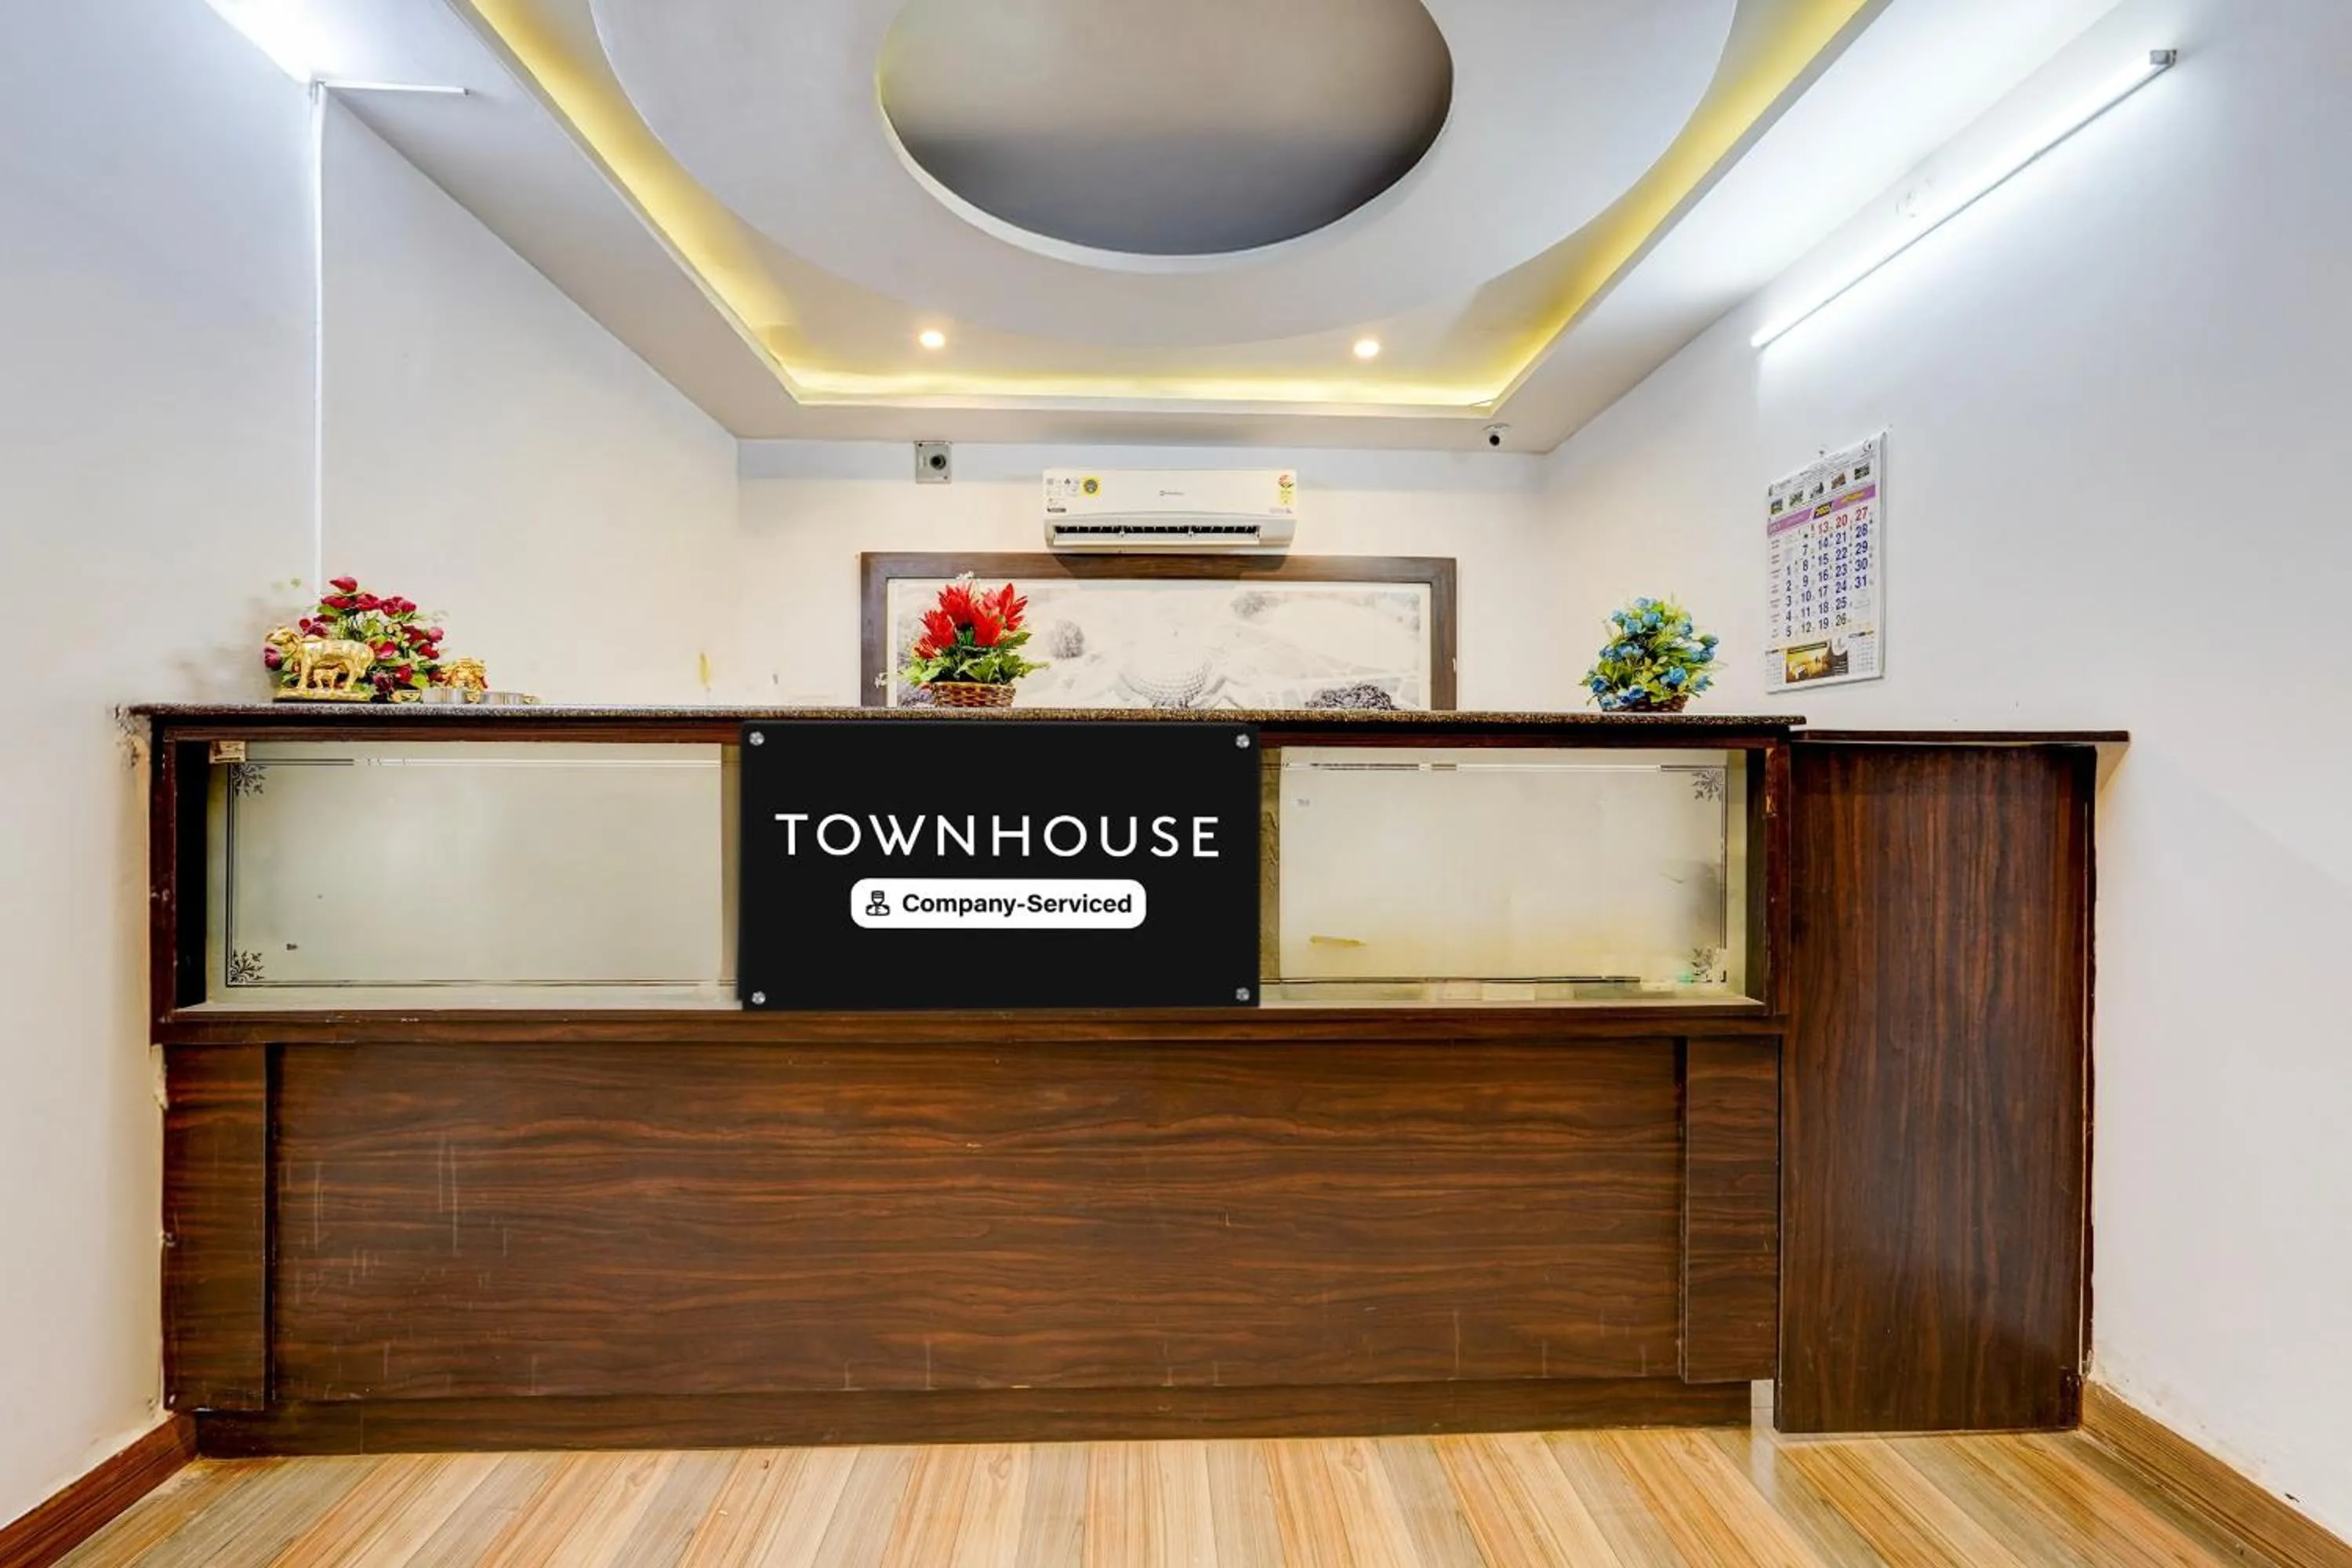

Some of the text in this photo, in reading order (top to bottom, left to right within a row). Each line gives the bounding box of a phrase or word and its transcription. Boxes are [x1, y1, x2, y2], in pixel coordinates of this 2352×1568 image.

[1818, 521, 1829, 534] 13
[1835, 514, 1848, 528] 20
[1856, 506, 1868, 521] 27
[1835, 532, 1846, 544] 21
[1818, 553, 1829, 566] 15
[1835, 547, 1848, 561] 22
[1856, 540, 1868, 555] 29
[1818, 568, 1829, 582] 16
[1835, 563, 1848, 577] 23
[1855, 557, 1868, 572] 30
[1802, 590, 1812, 602] 10
[1818, 585, 1828, 597] 17
[1835, 579, 1846, 593] 24
[1855, 575, 1867, 588] 31
[1802, 606, 1810, 618] 11
[1818, 601, 1829, 614] 18
[1835, 596, 1847, 610] 25
[1802, 621, 1812, 633] 12
[1818, 617, 1829, 630] 19
[1835, 612, 1847, 626] 26
[775, 813, 1219, 858] TOWNHOUSE
[902, 892, 1132, 916] Company-Serviced
